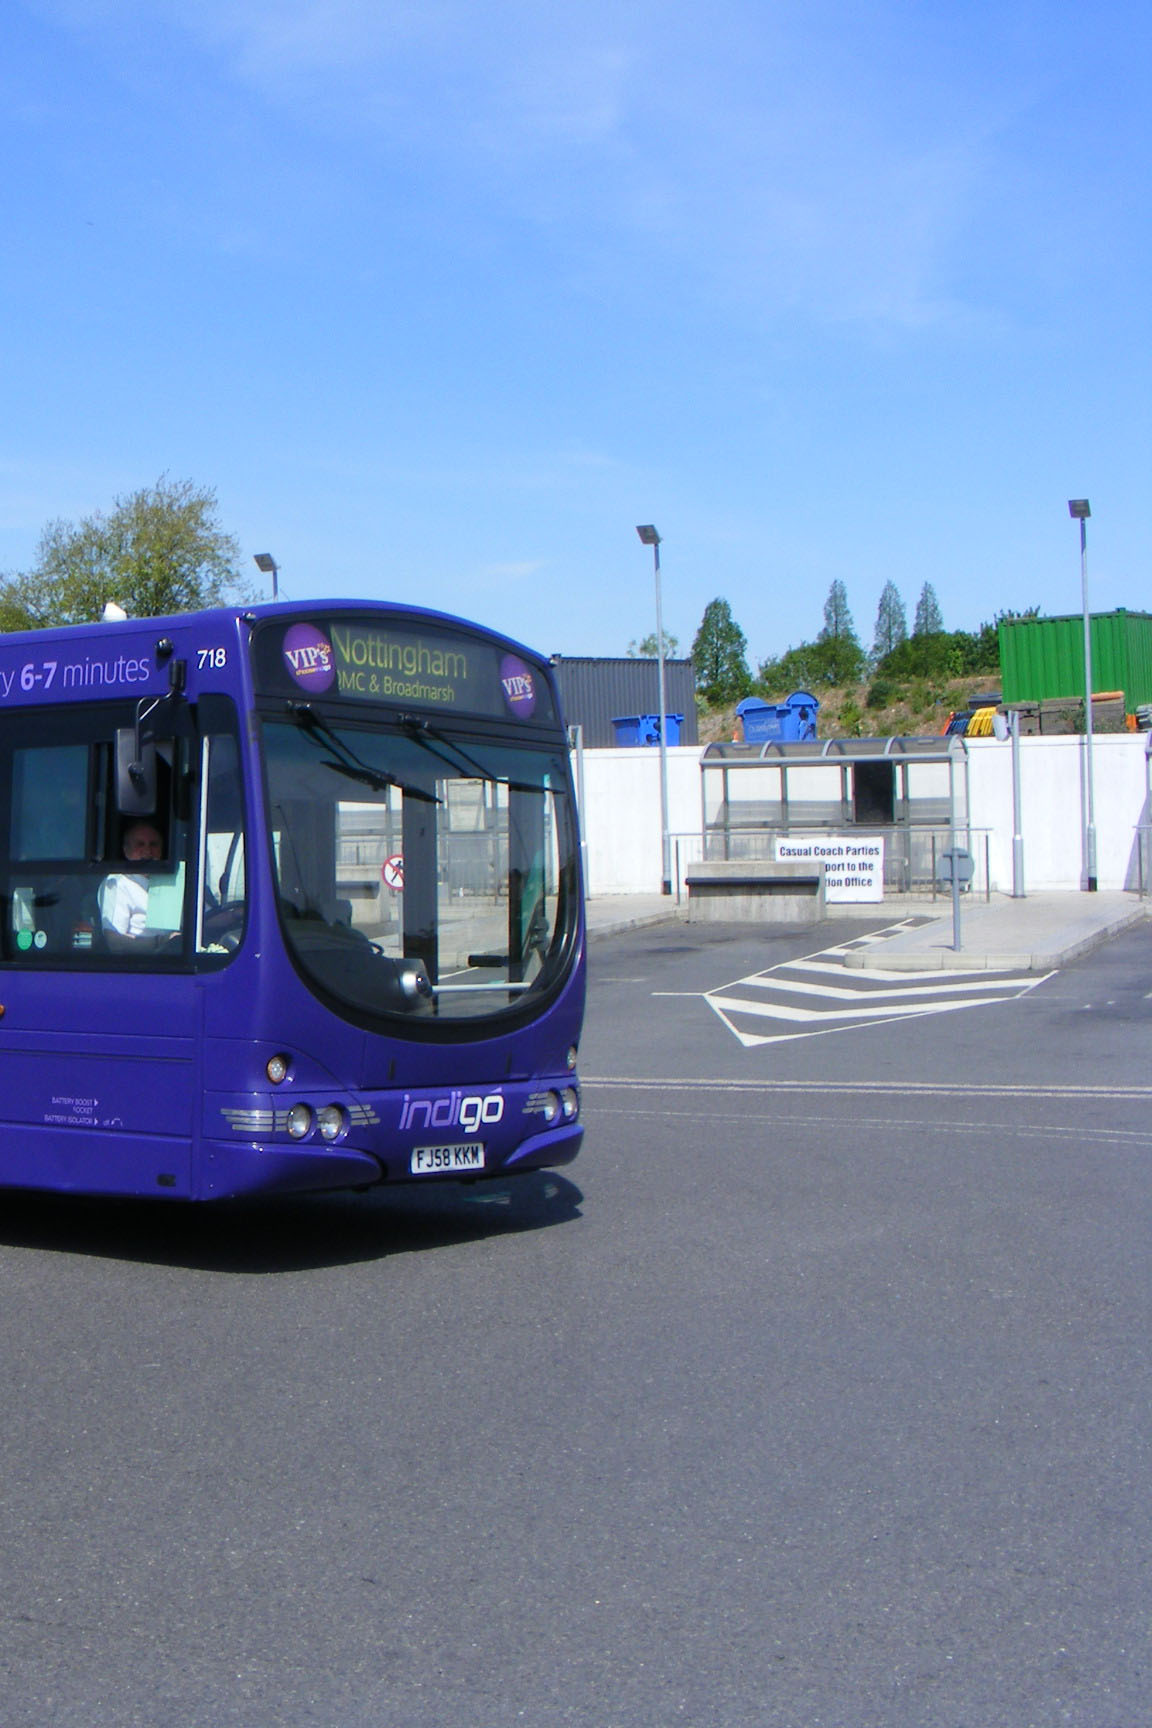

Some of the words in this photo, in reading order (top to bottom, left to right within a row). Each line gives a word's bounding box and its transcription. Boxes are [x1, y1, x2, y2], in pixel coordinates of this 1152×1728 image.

[197, 648, 227, 669] 718
[285, 646, 329, 669] VIP's
[330, 624, 467, 679] Nottingham
[20, 662, 57, 690] 6-7
[63, 656, 150, 688] minutes
[369, 673, 380, 693] &
[383, 676, 455, 702] Broadmarsh
[779, 846, 812, 856] Casual
[813, 846, 843, 856] Coach
[845, 846, 880, 856] Parties
[825, 862, 845, 872] port
[847, 862, 856, 871] to
[858, 861, 874, 871] the
[844, 877, 873, 887] Office
[51, 1096, 74, 1105] BATTERY
[399, 1087, 504, 1133] indigo
[416, 1148, 450, 1169] FJ58
[454, 1146, 480, 1166] KKM
